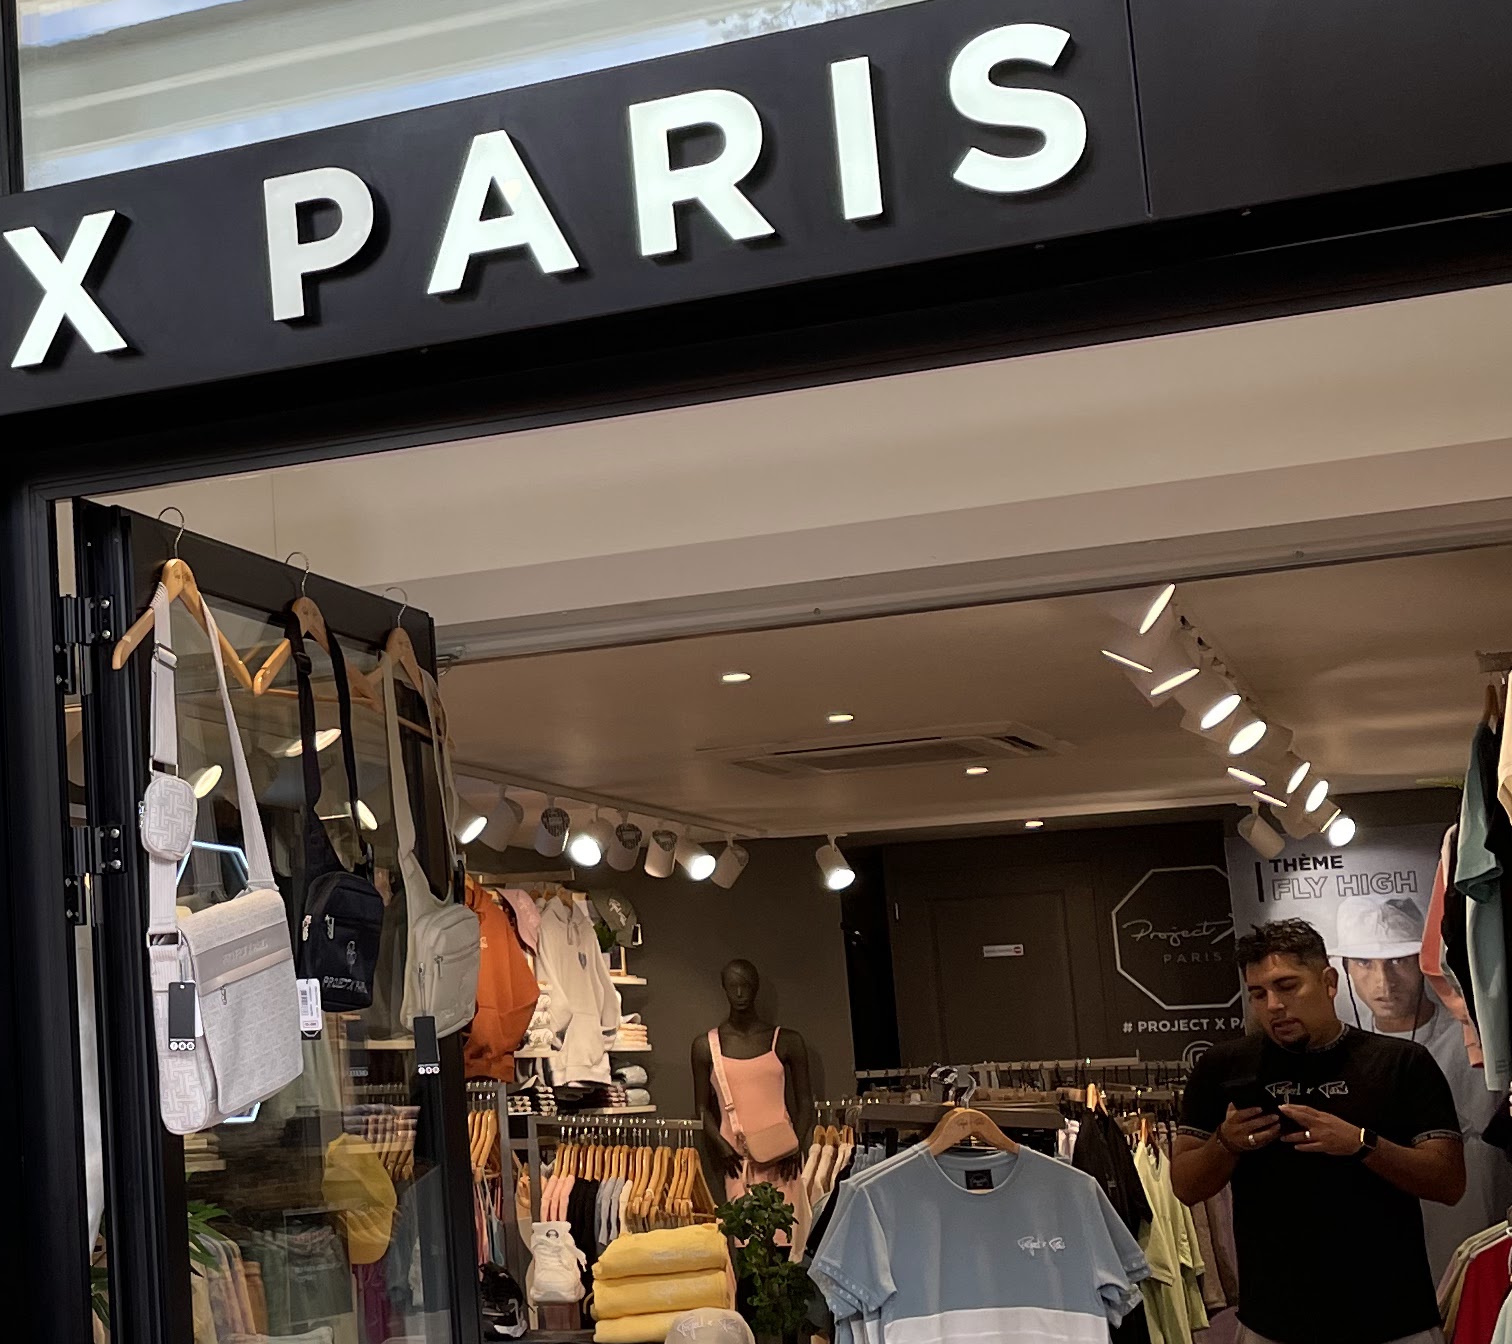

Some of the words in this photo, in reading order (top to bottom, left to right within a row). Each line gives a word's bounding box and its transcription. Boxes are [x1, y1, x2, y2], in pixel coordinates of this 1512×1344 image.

[2, 209, 130, 370] X
[262, 22, 1090, 323] PARIS
[1268, 853, 1345, 873] THÈME
[1271, 875, 1329, 901] FLY
[1335, 870, 1418, 898] HIGH
[1122, 919, 1233, 947] Project
[1163, 951, 1223, 964] PARIS
[1137, 1019, 1209, 1033] PROJECT
[1215, 1017, 1225, 1030] X
